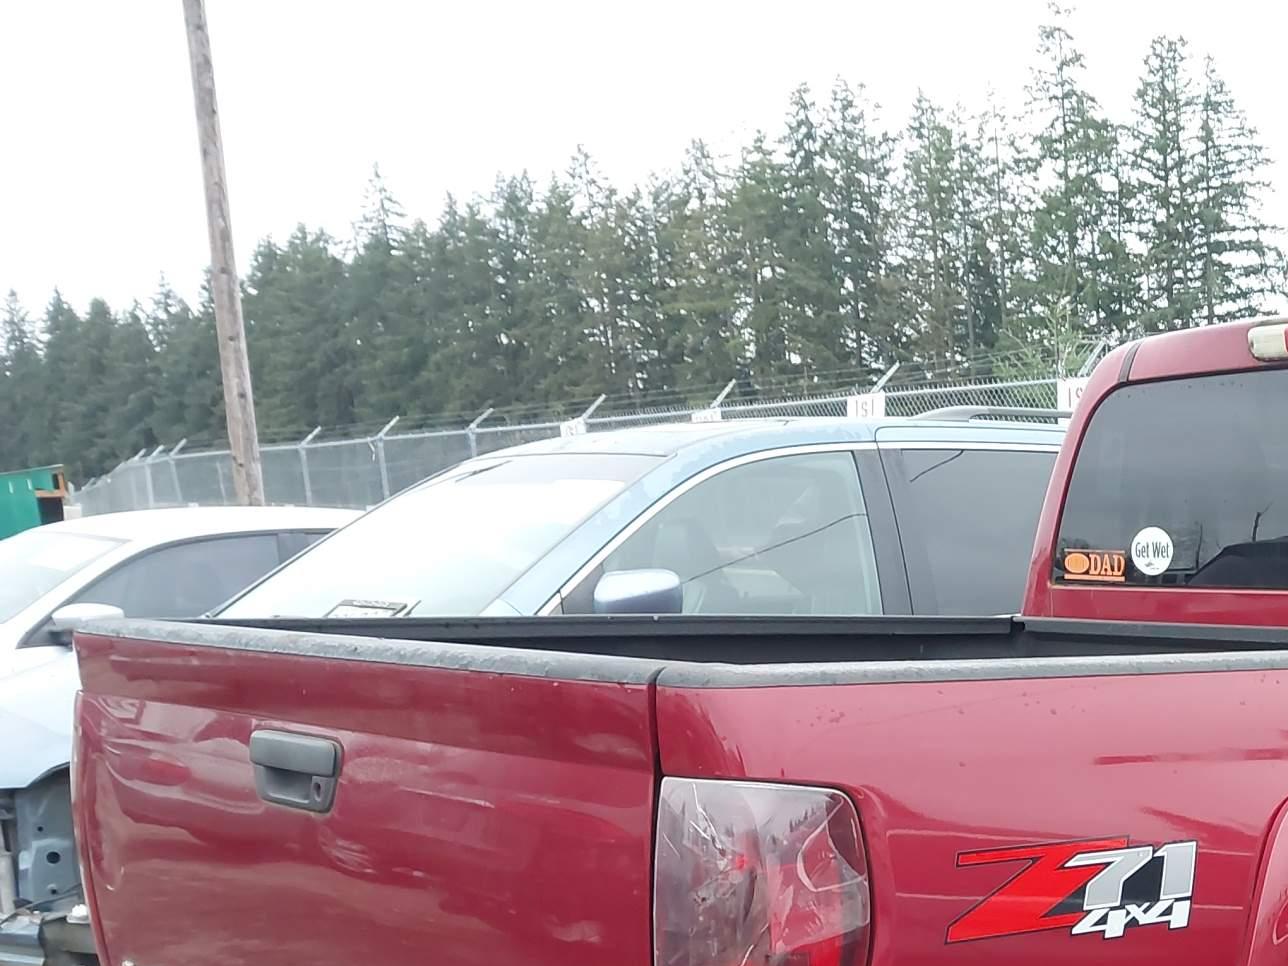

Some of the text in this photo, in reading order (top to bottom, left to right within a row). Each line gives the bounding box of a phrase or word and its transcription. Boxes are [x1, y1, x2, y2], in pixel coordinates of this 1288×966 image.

[1135, 541, 1170, 559] Get Wet
[1089, 553, 1125, 576] DAD
[945, 835, 1197, 944] Z71
